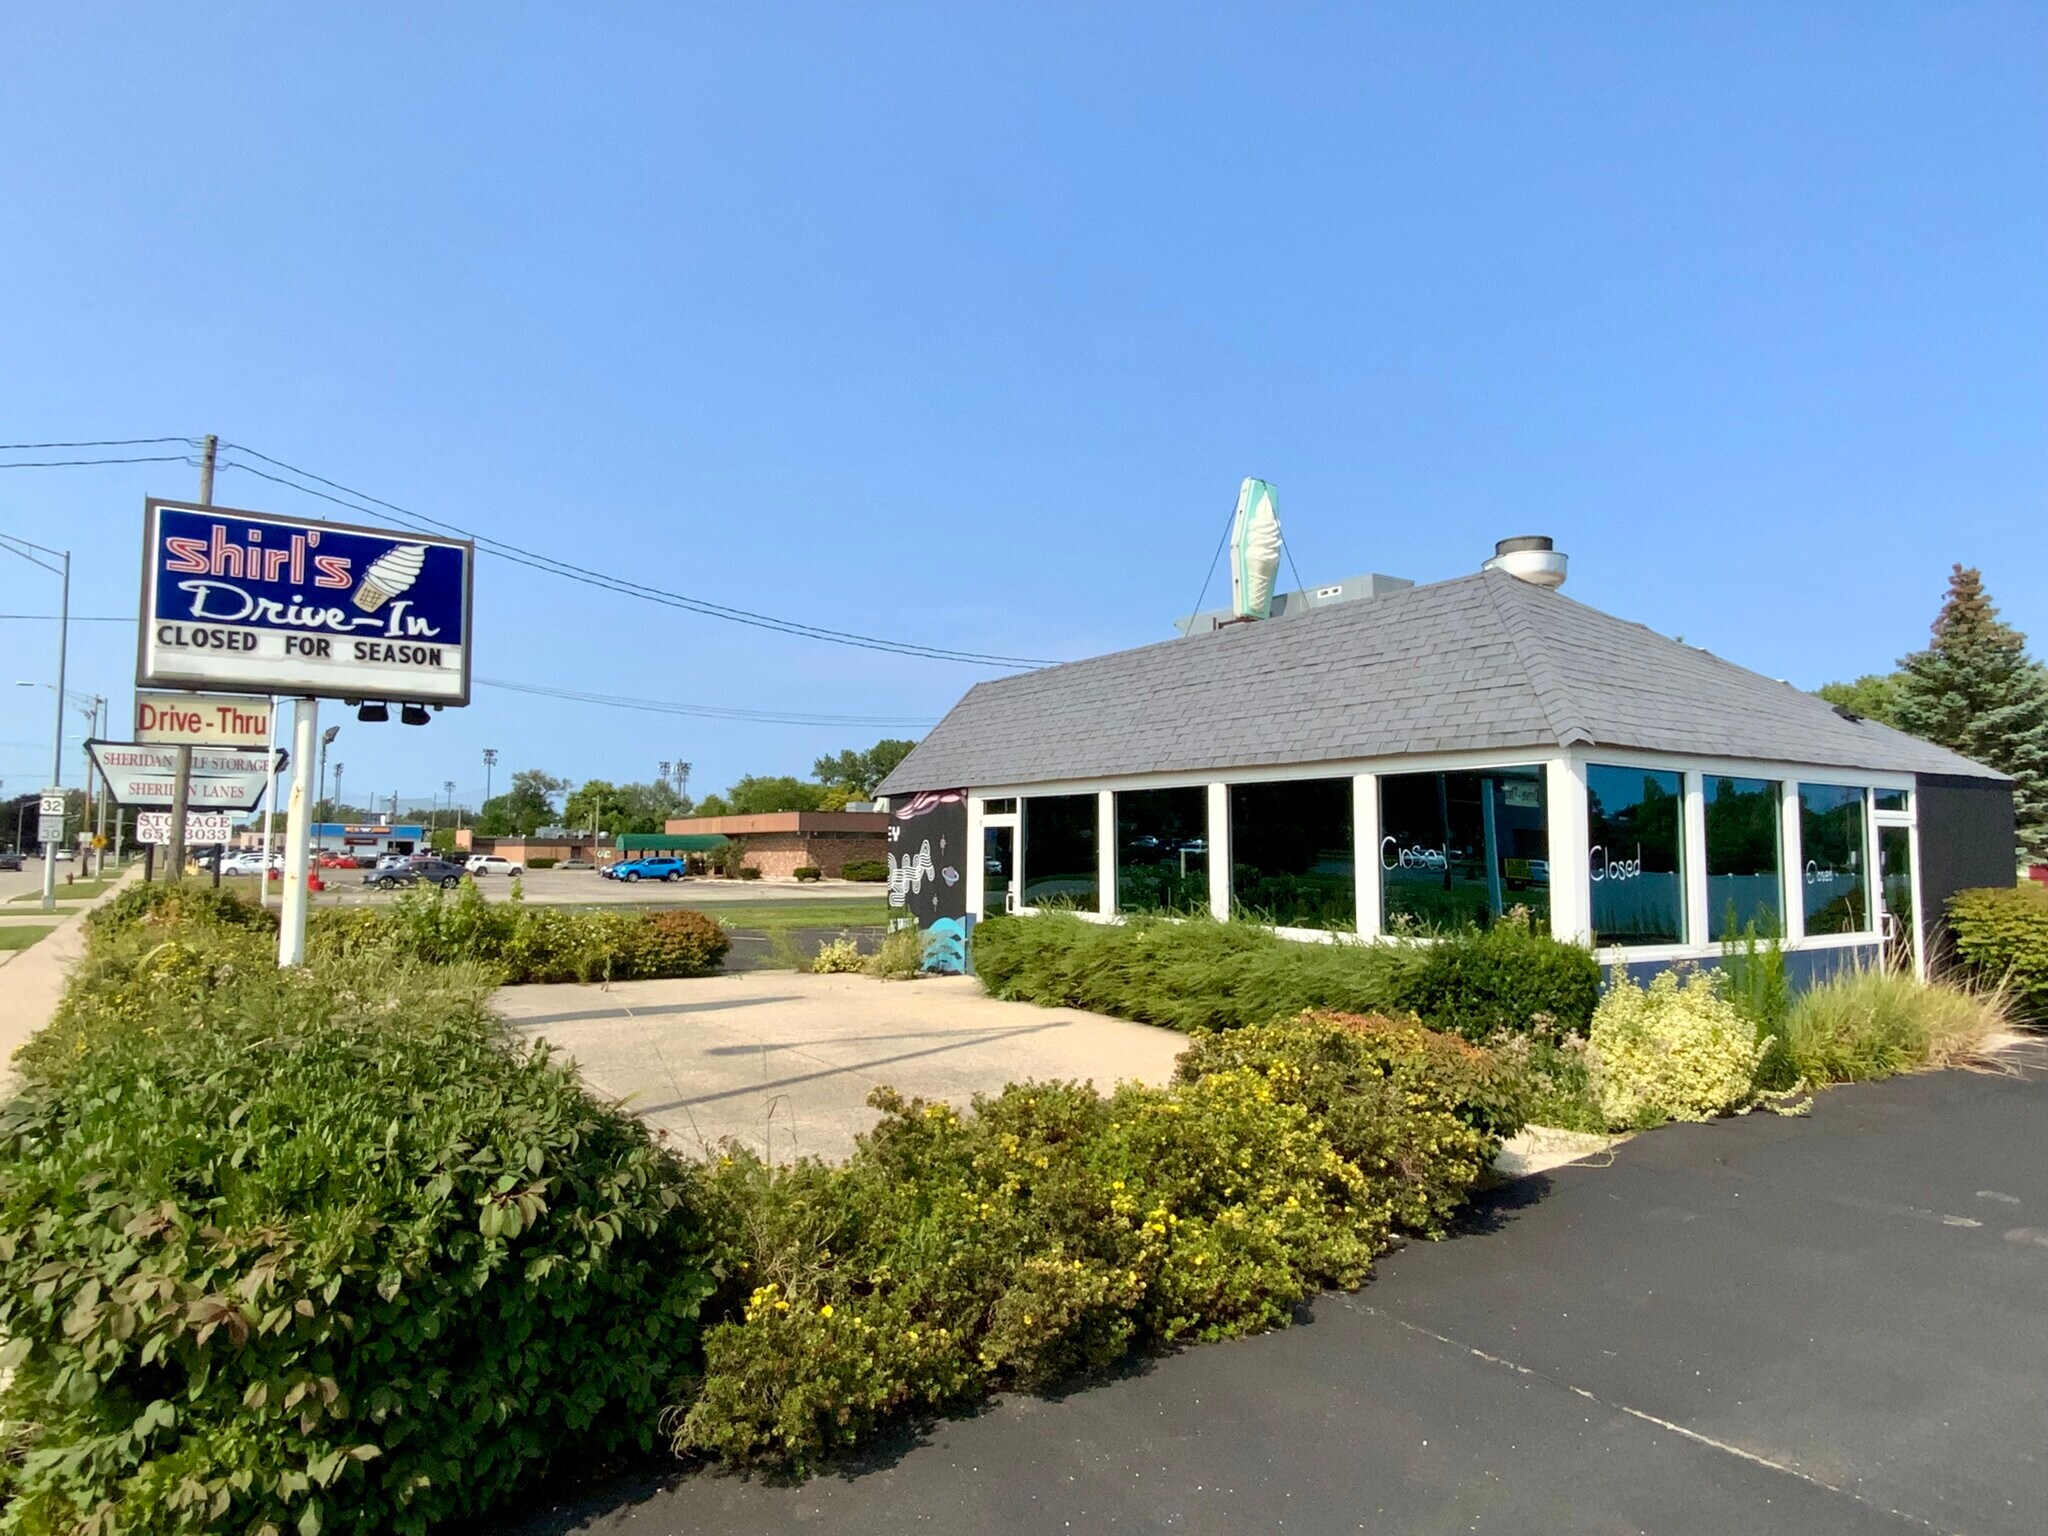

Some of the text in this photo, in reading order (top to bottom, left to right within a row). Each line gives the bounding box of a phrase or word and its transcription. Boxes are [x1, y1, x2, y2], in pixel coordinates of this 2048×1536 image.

[178, 579, 441, 637] Drive-In
[157, 625, 442, 667] CLOSED FOR SEASON
[103, 751, 174, 768] SHERIDAN
[212, 757, 270, 772] STORAGE
[203, 784, 245, 798] LANES
[42, 800, 61, 812] 32
[42, 829, 61, 840] 30
[1589, 842, 1641, 881] Closed
